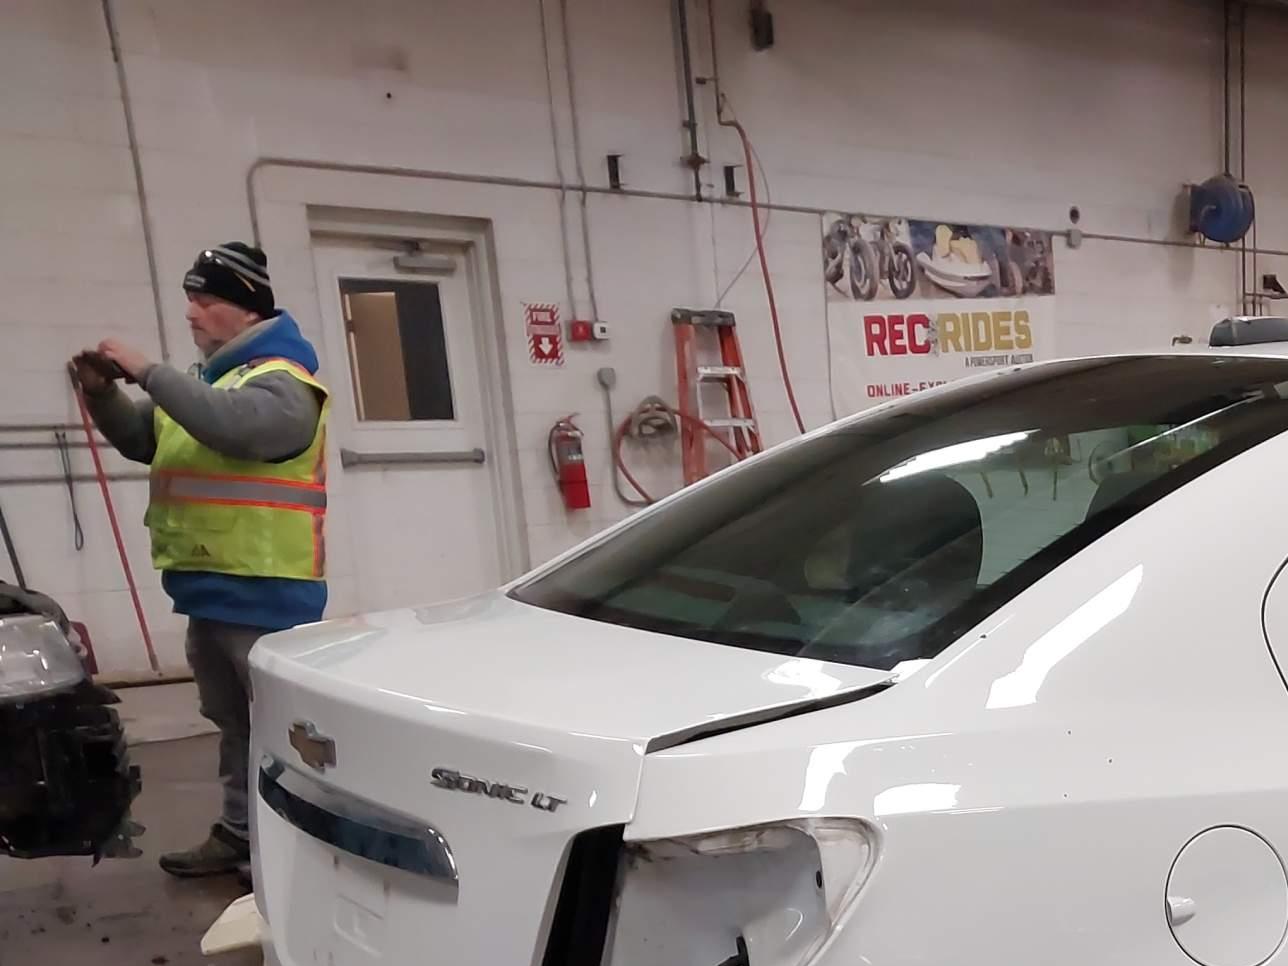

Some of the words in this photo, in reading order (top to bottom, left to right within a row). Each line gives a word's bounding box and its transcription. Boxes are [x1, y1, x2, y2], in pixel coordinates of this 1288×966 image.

[864, 314, 931, 356] REC
[938, 310, 1032, 352] RIDES
[430, 767, 528, 805] SONIC
[530, 792, 568, 813] LT
